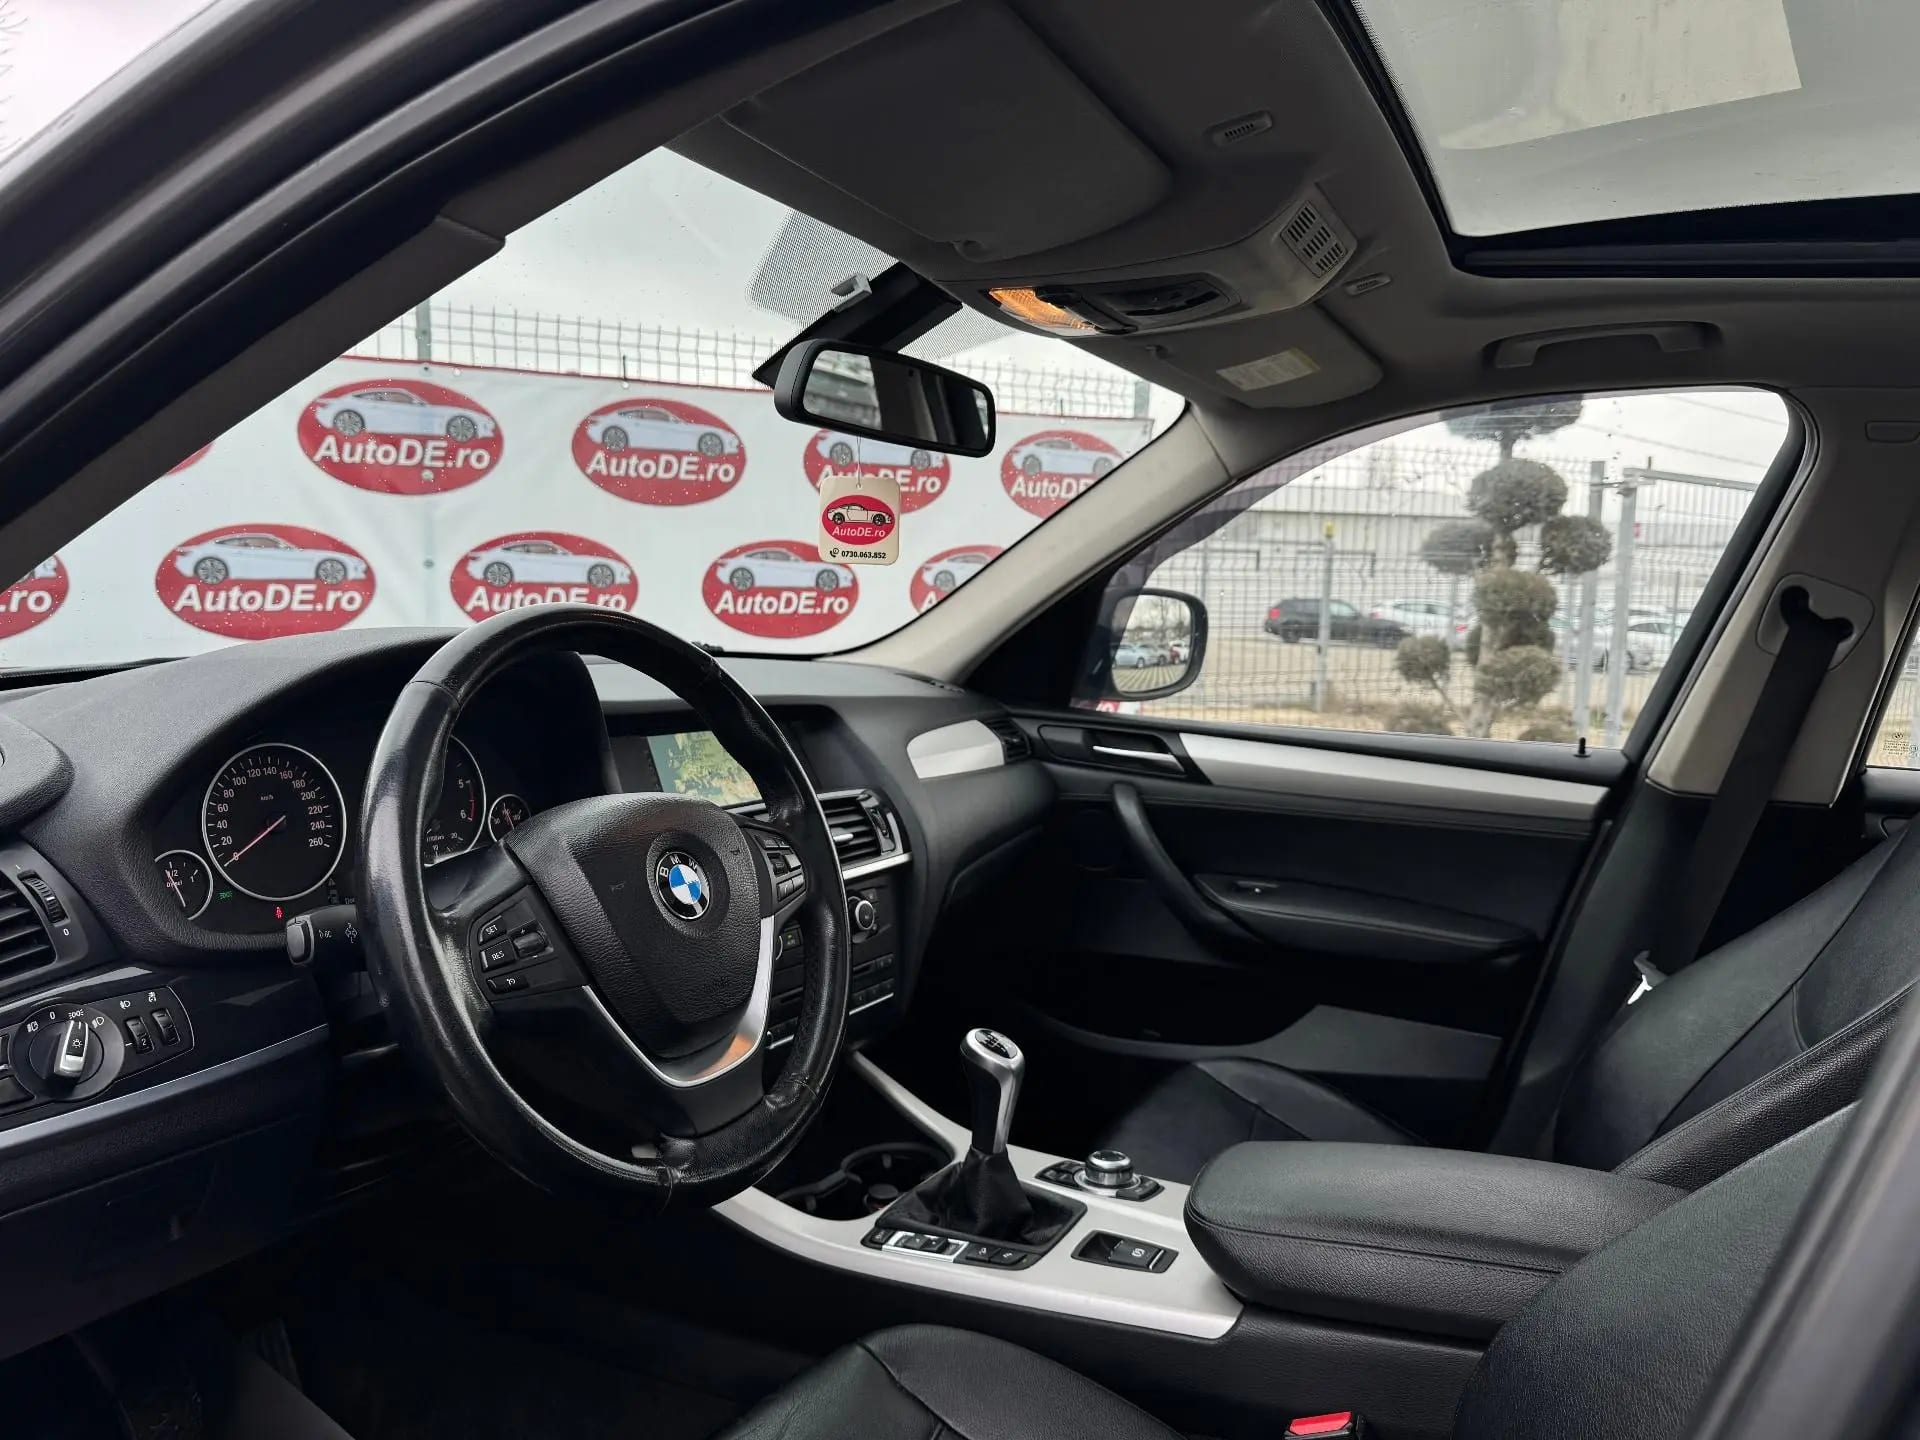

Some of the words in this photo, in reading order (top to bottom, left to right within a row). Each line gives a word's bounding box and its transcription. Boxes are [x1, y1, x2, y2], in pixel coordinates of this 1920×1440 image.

[313, 434, 491, 470] AutoDE.ro
[586, 451, 736, 483] AutoDE.ro
[832, 526, 886, 538] AutoDE.ro
[841, 550, 887, 559] 0730.063.852
[174, 583, 363, 612] AutoDE.ro
[714, 589, 850, 615] AutoDE.ro
[247, 768, 261, 778] 120
[263, 766, 277, 775] 140
[280, 770, 293, 779] 160
[232, 776, 247, 786] 100
[292, 779, 306, 789] 180
[458, 779, 464, 788] 5
[223, 789, 235, 798] 80
[300, 791, 316, 801] 200
[217, 804, 229, 813] 60
[308, 805, 323, 815] 220
[460, 810, 466, 819] 6
[216, 820, 228, 829] 40
[310, 820, 325, 830] 240
[221, 836, 233, 845] 20
[308, 837, 324, 847] 260
[660, 854, 698, 877] BMW
[485, 924, 498, 935] SET
[491, 950, 505, 960] RES
